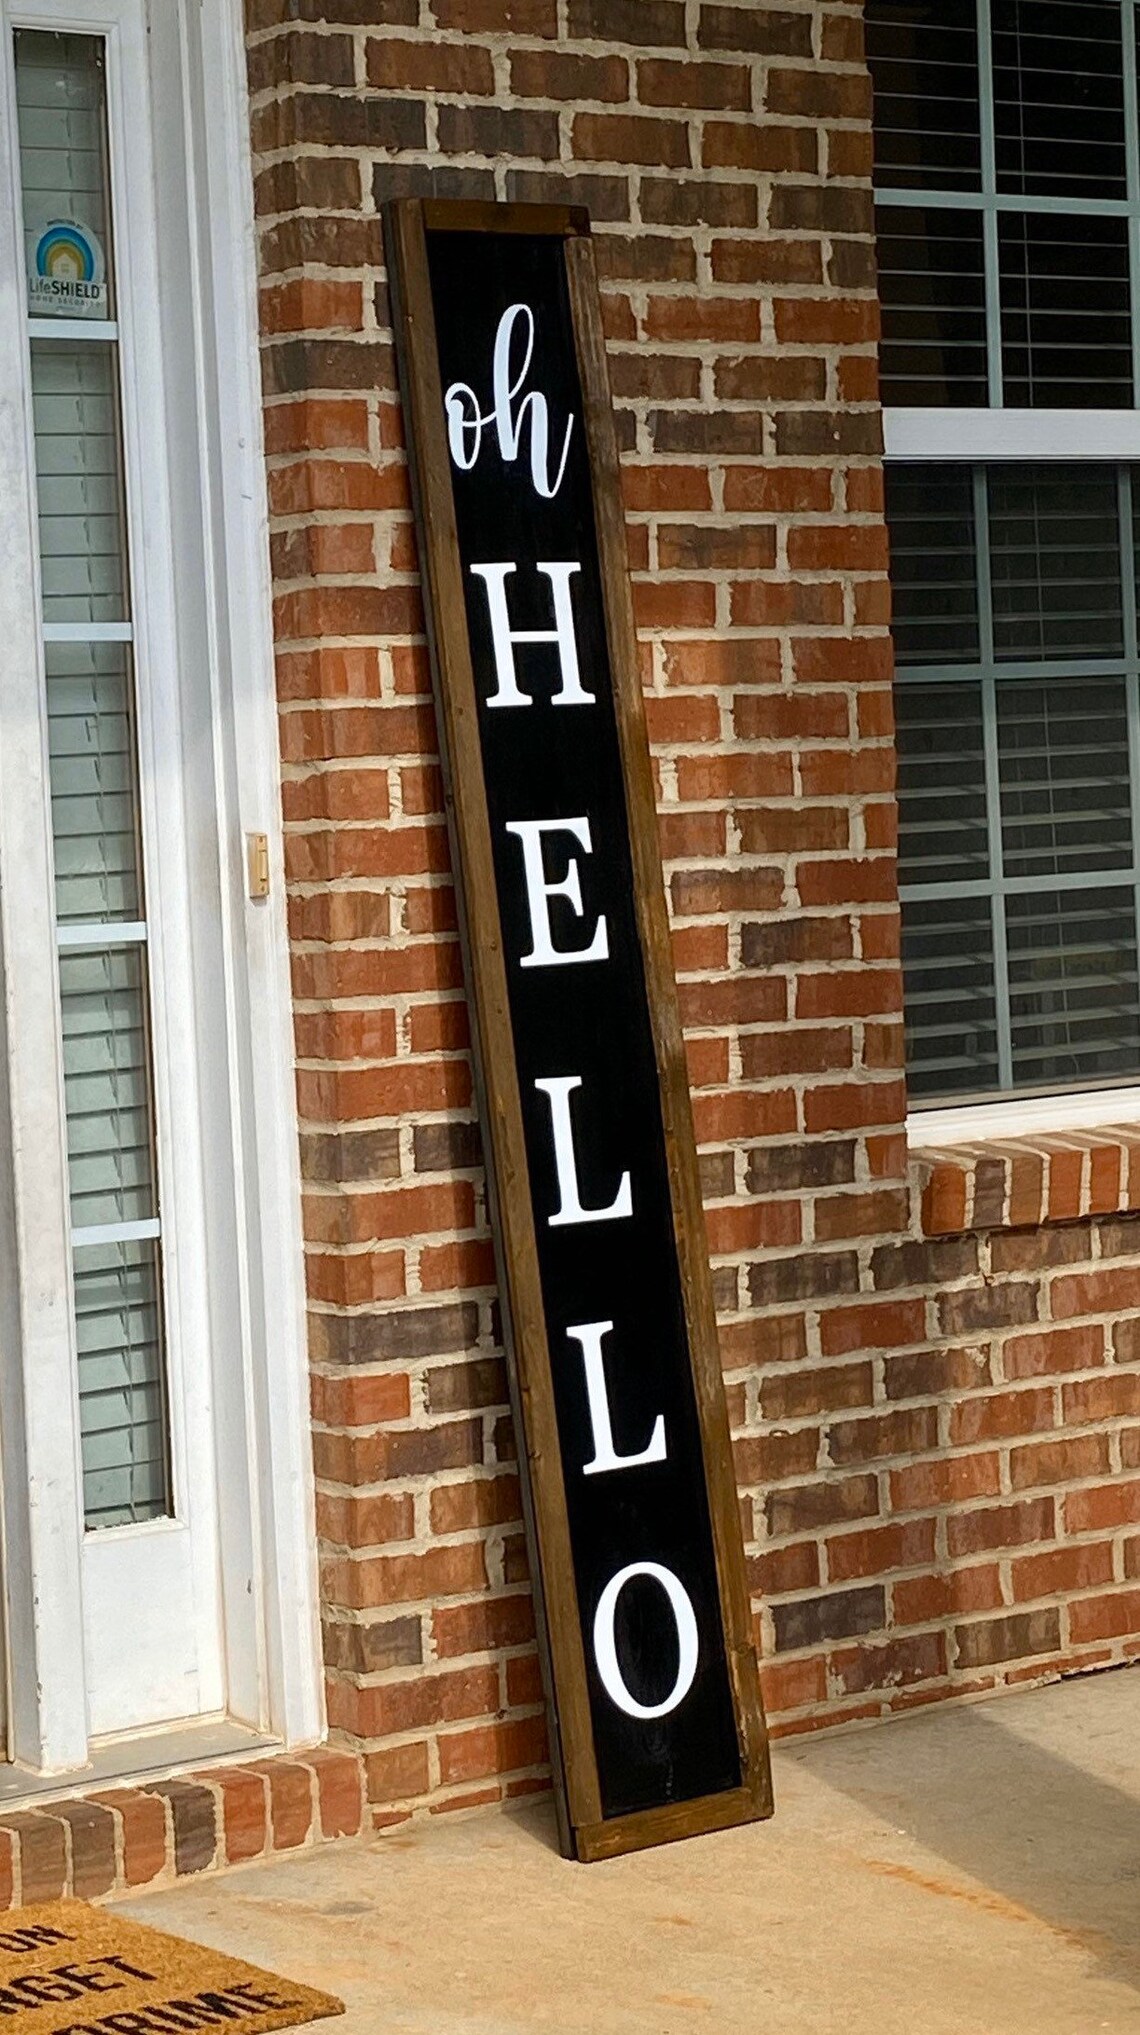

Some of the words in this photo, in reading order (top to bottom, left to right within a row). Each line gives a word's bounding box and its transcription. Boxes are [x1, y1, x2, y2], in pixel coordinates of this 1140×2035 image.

[30, 278, 100, 299] LifeSHIELD
[445, 304, 573, 498] oh
[470, 561, 700, 1719] HELLO
